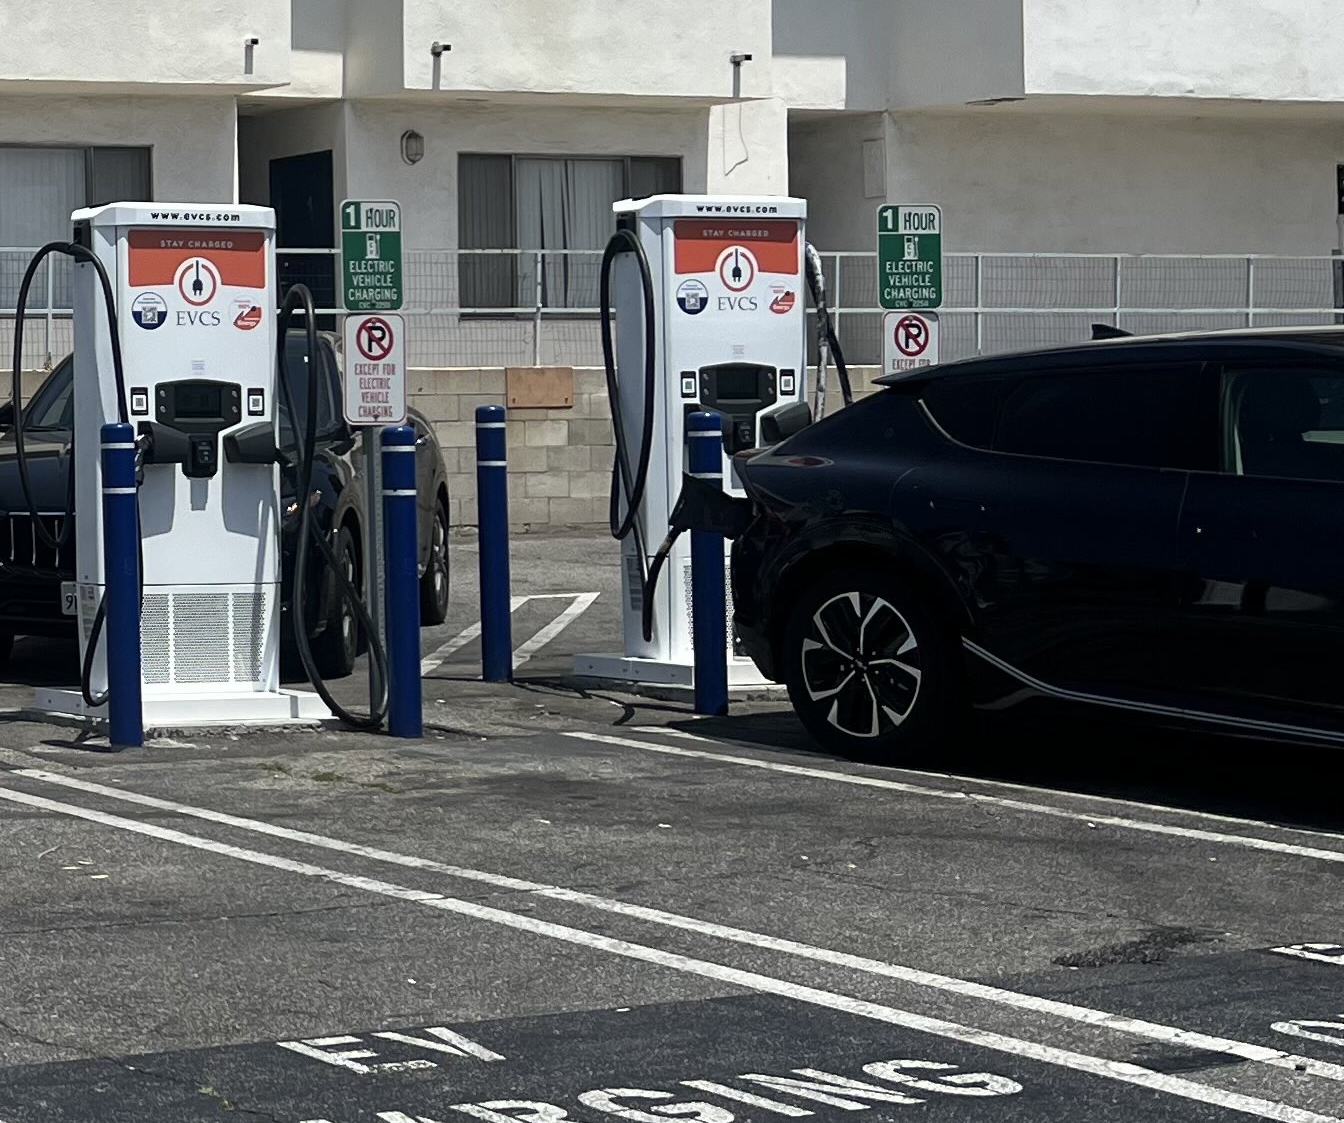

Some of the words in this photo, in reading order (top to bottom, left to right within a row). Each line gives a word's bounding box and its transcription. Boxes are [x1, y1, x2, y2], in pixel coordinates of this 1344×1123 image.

[345, 204, 356, 227] 1
[365, 208, 396, 228] HOUR
[696, 205, 778, 214] www.evcs.com
[150, 212, 240, 222] www.evcs.com
[882, 208, 894, 230] 1
[903, 211, 936, 231] HOUR
[702, 229, 724, 237] STAY
[160, 239, 183, 248] STAY
[187, 240, 234, 249] CHARGED
[349, 260, 395, 273] ELECTRIC
[885, 261, 934, 273] ELECTRIC
[352, 274, 393, 287] VEHICLE
[888, 274, 932, 286] VEHICLE
[348, 288, 398, 301] CHARGING
[884, 287, 937, 300] CHARGING
[717, 296, 758, 311] EVCS
[175, 310, 221, 327] EVCS
[354, 363, 380, 376] EXCEPT
[359, 377, 391, 390] ELECTRIC
[361, 391, 390, 404] VEHICLE
[275, 1026, 507, 1075] EV
